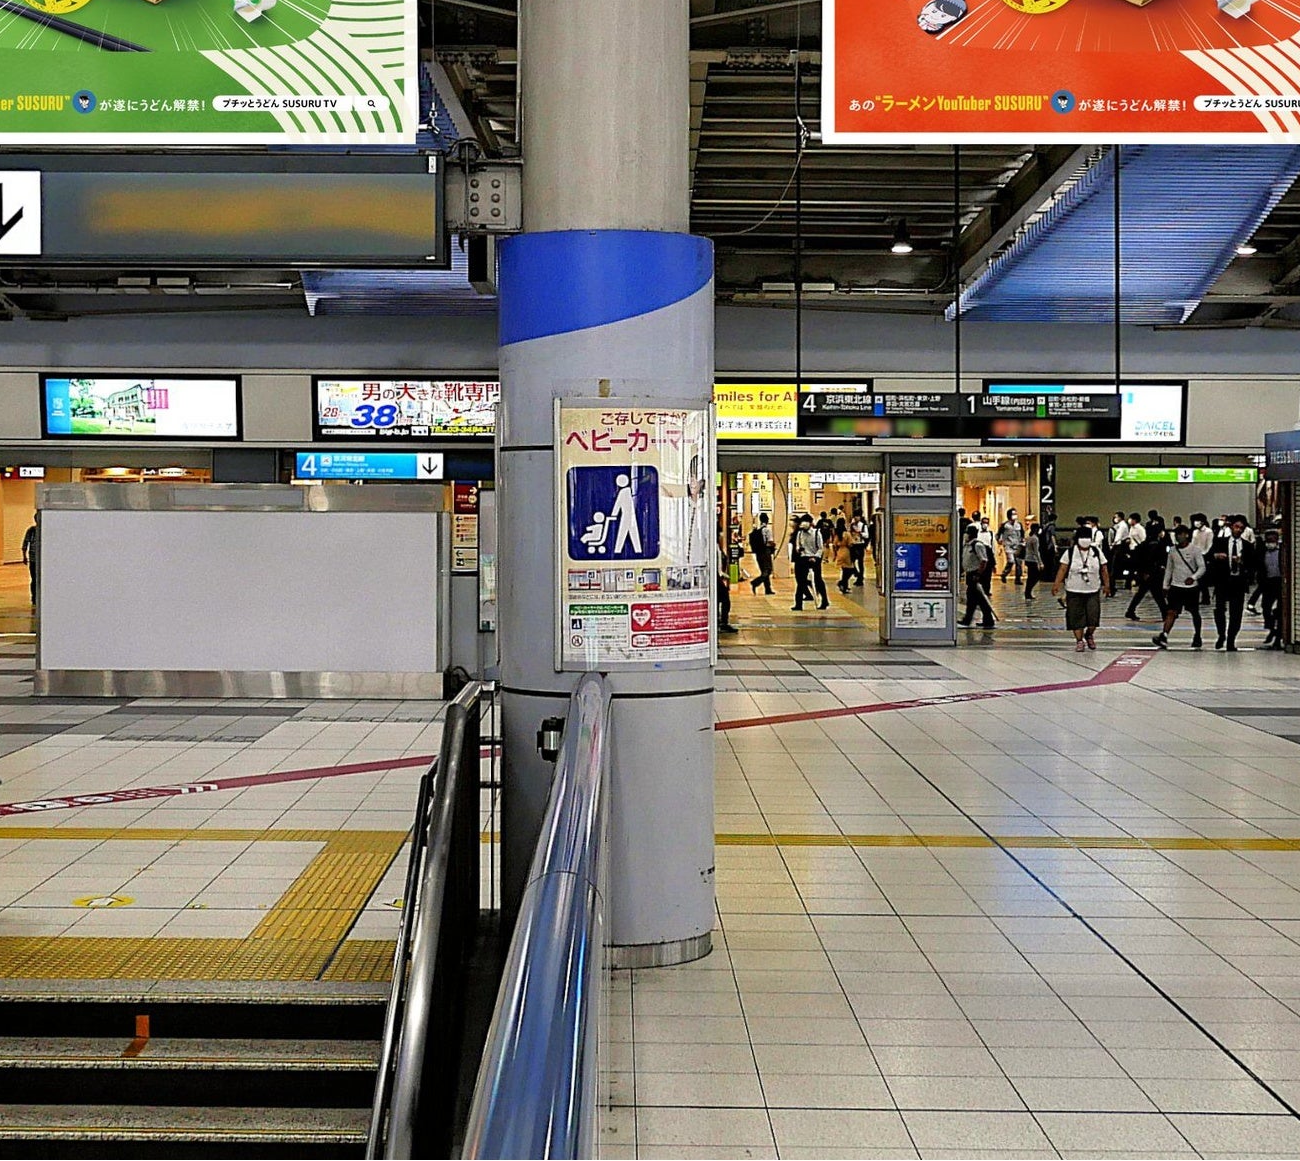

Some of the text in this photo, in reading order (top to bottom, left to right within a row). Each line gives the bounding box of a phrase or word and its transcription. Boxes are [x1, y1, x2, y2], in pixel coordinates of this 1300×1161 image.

[100, 99, 206, 113] が遂にうどん解禁!
[222, 99, 337, 108] プチッとうどん SUSURU TV
[1079, 99, 1187, 112] が遂にうどん解禁!
[1204, 99, 1262, 109] プチッとうどん
[759, 392, 779, 402] for
[826, 395, 872, 404] 京浜東北線
[983, 396, 1035, 405] 山手線(内回り)
[803, 395, 817, 412] 4
[967, 395, 975, 413] 1
[351, 405, 396, 426] 38
[1135, 421, 1176, 430] DAICEL
[301, 455, 317, 475] 4
[1115, 470, 1123, 481] 2
[815, 492, 823, 504] F
[1041, 486, 1053, 503] 2
